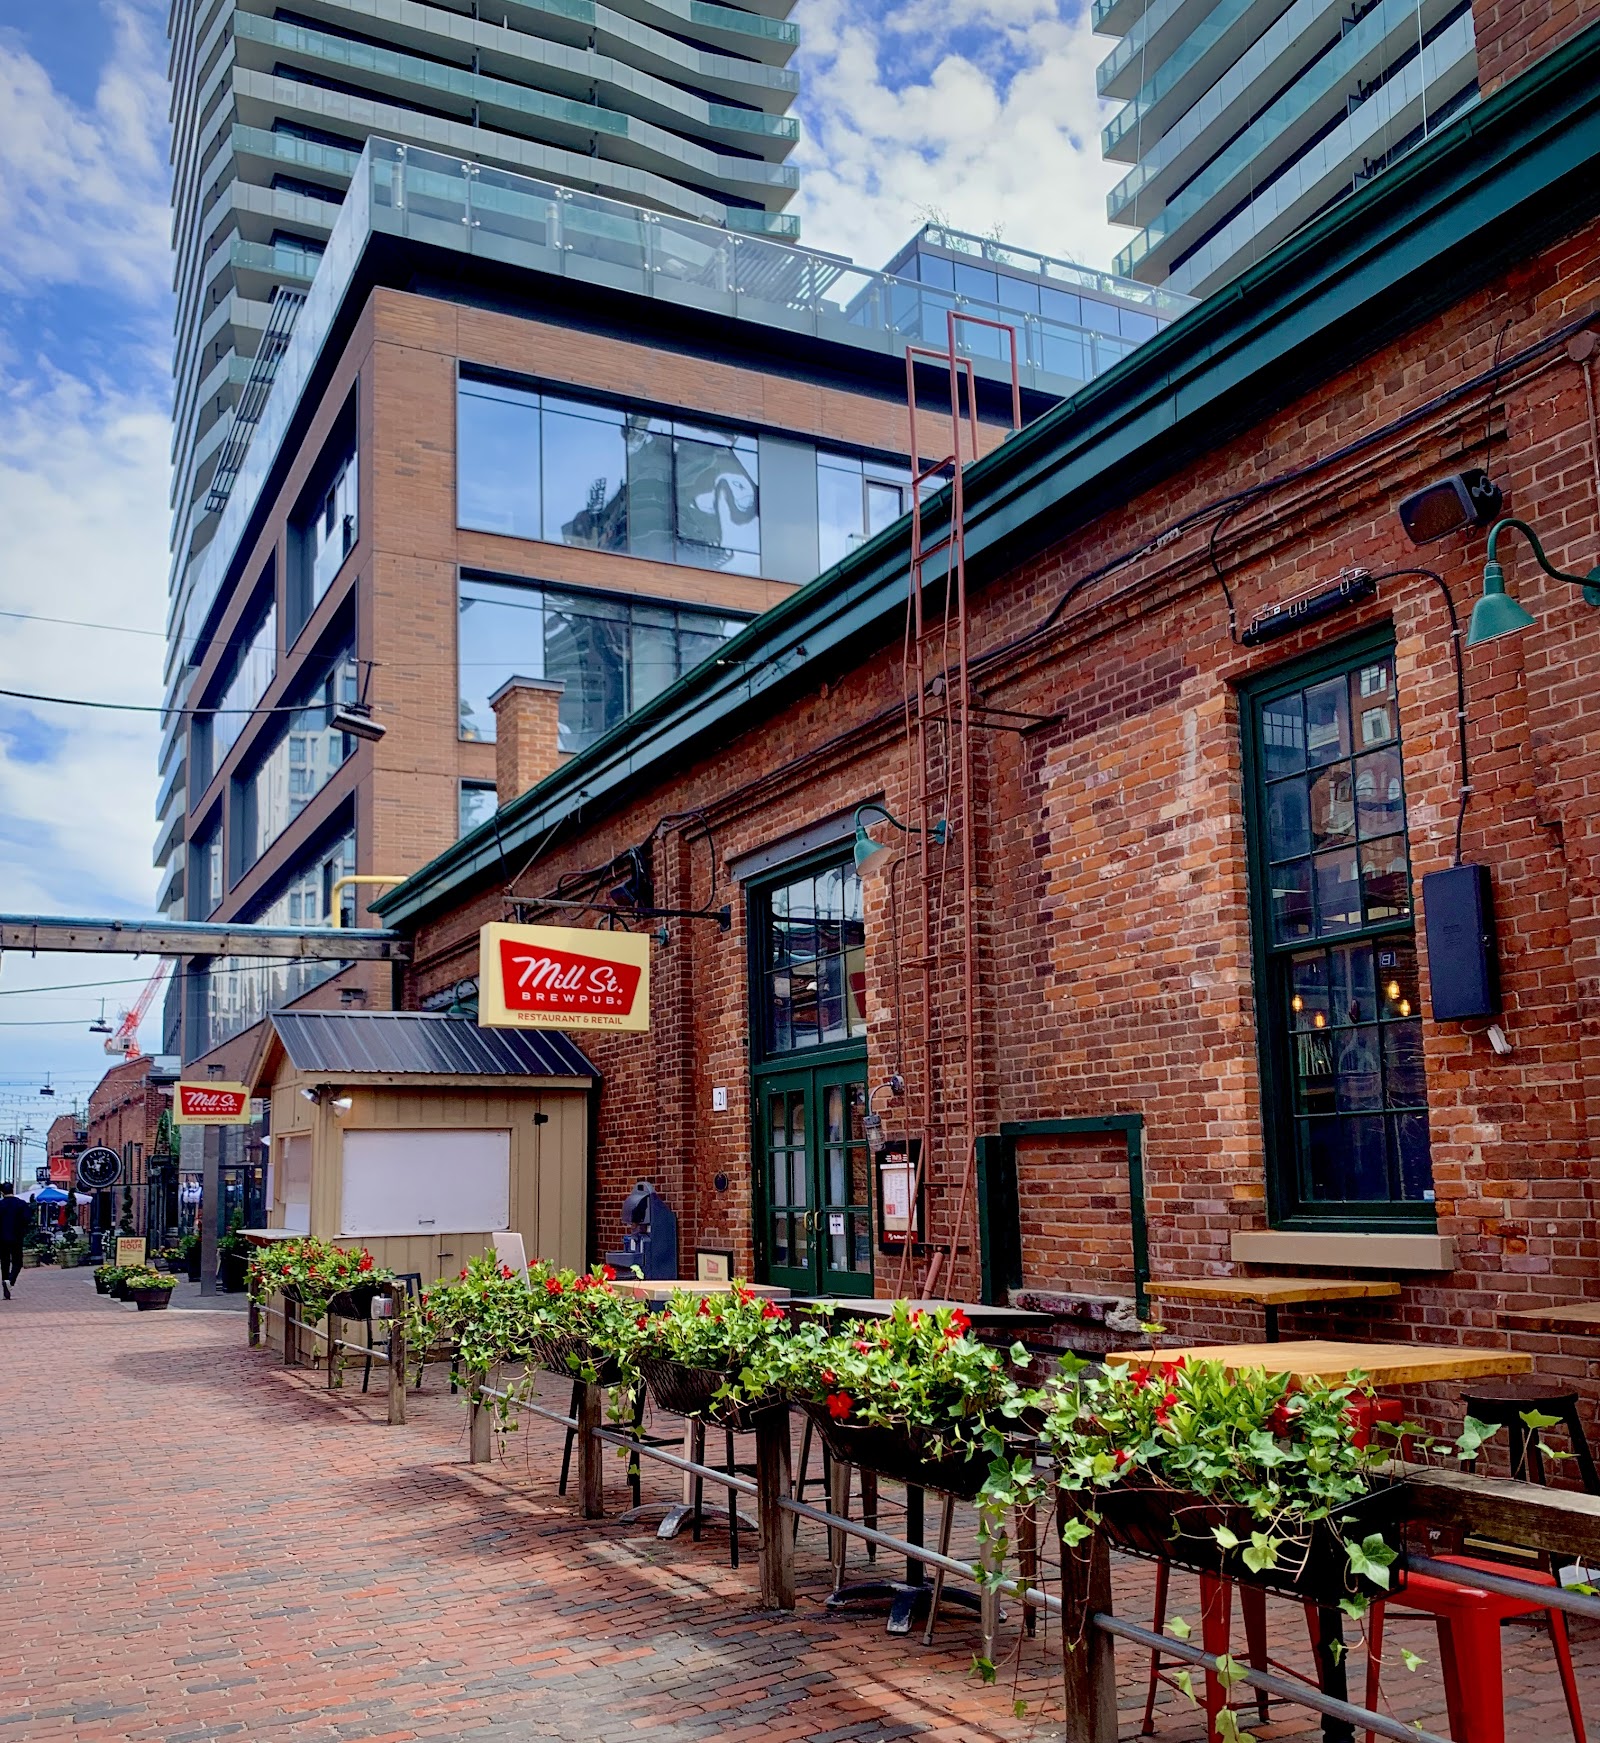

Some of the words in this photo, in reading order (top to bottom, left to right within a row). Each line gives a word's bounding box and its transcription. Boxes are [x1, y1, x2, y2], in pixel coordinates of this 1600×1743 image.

[512, 956, 586, 990] Mill
[586, 966, 624, 993] St.
[521, 991, 615, 1005] BREWPUB
[517, 1012, 581, 1023] RESTAURANT
[583, 1015, 589, 1024] &
[591, 1016, 623, 1025] RETAIL
[183, 1091, 219, 1107] Mill
[219, 1093, 238, 1107] St.
